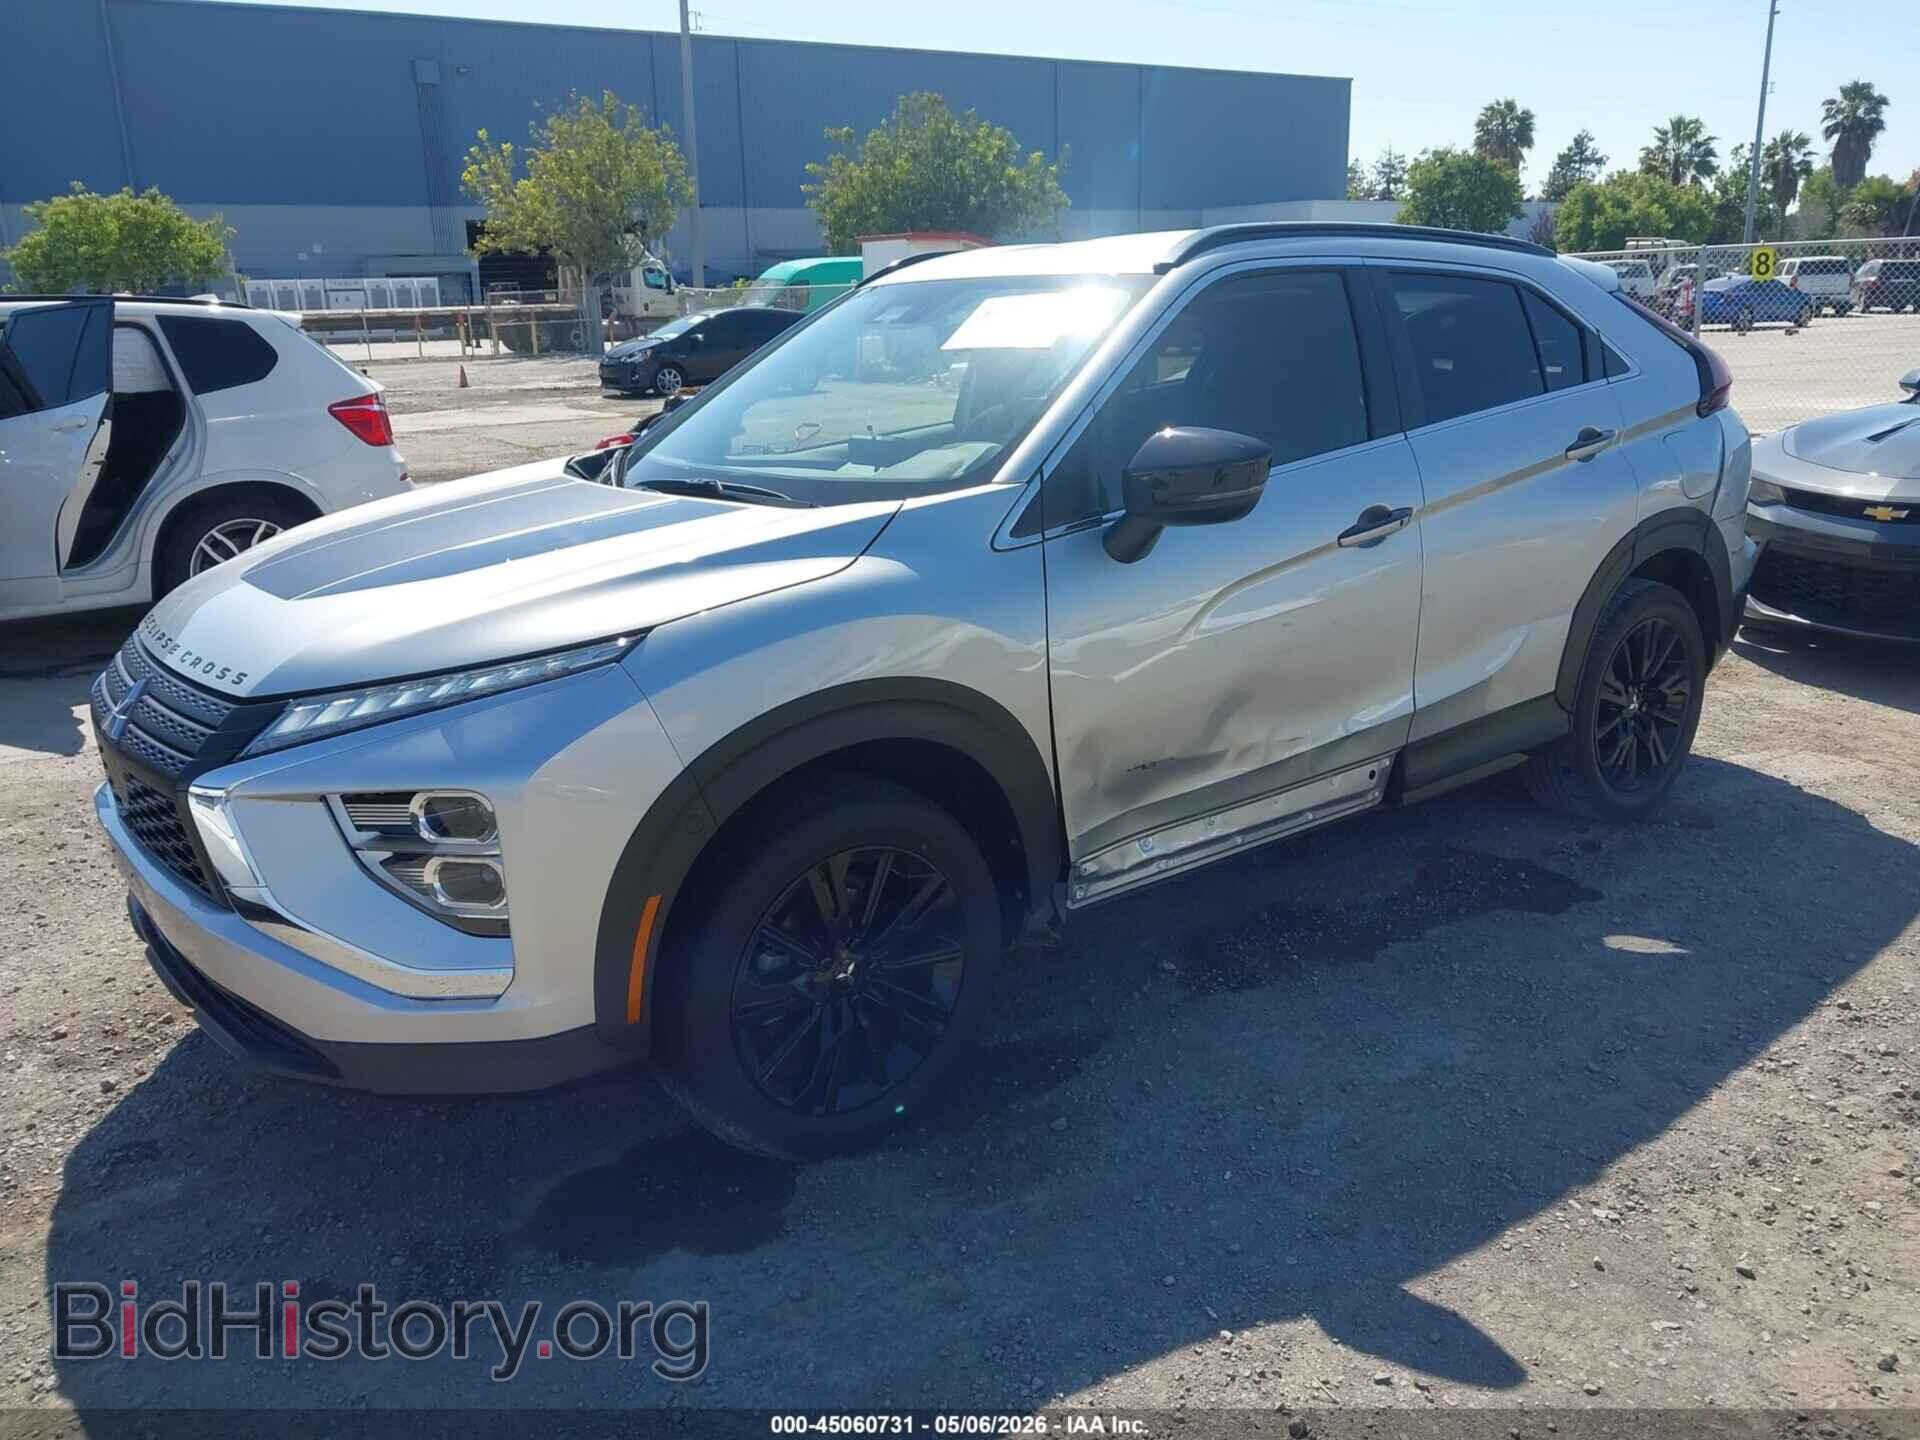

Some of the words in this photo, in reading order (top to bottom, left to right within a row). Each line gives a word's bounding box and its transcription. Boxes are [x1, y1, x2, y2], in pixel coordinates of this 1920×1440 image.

[1756, 252, 1770, 276] 8
[143, 613, 181, 655] ECLIPSE
[179, 649, 249, 686] CROSS
